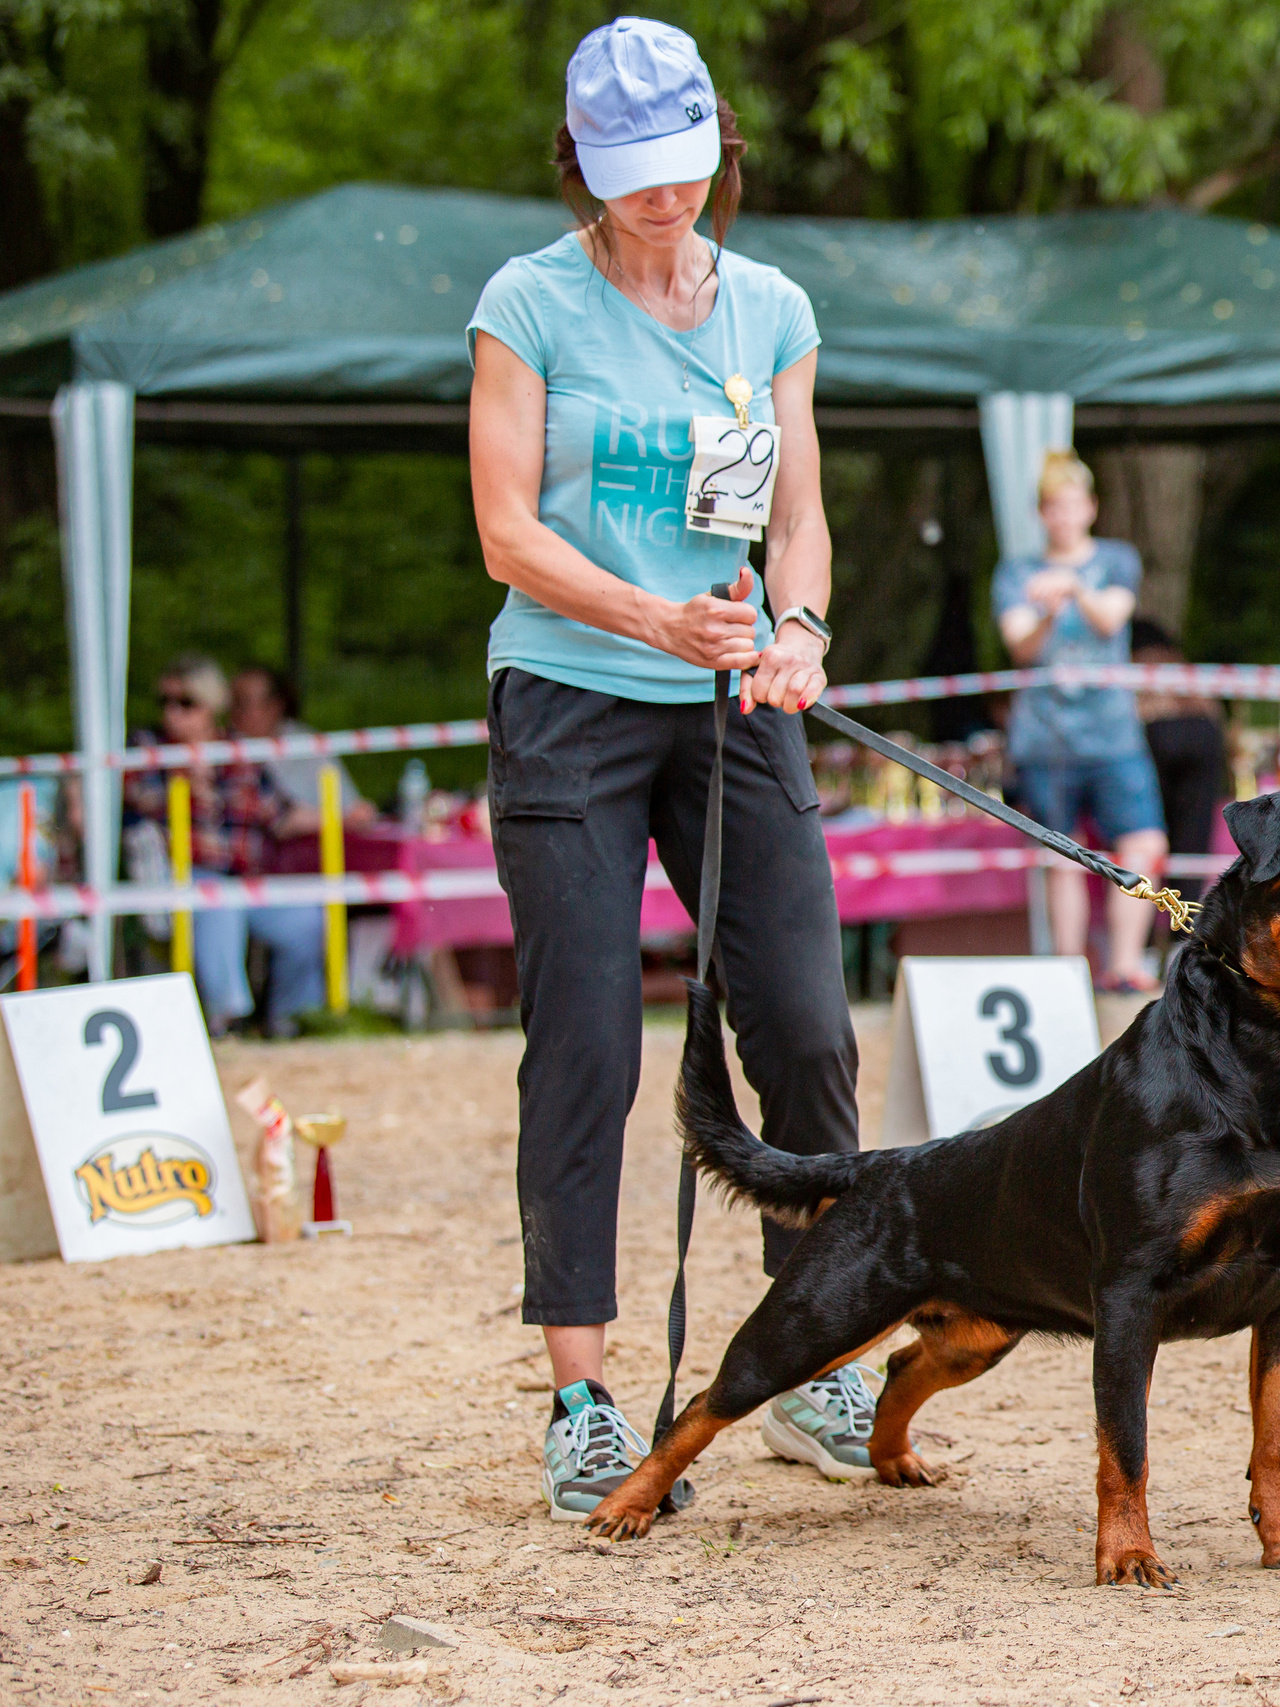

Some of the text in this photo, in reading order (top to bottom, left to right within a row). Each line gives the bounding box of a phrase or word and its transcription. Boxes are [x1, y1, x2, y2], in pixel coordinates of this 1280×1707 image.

[607, 402, 715, 462] RU
[700, 429, 775, 499] 29
[645, 465, 691, 496] TH
[83, 1009, 158, 1113] 2
[980, 987, 1041, 1086] 3
[76, 1147, 213, 1222] Nutro
